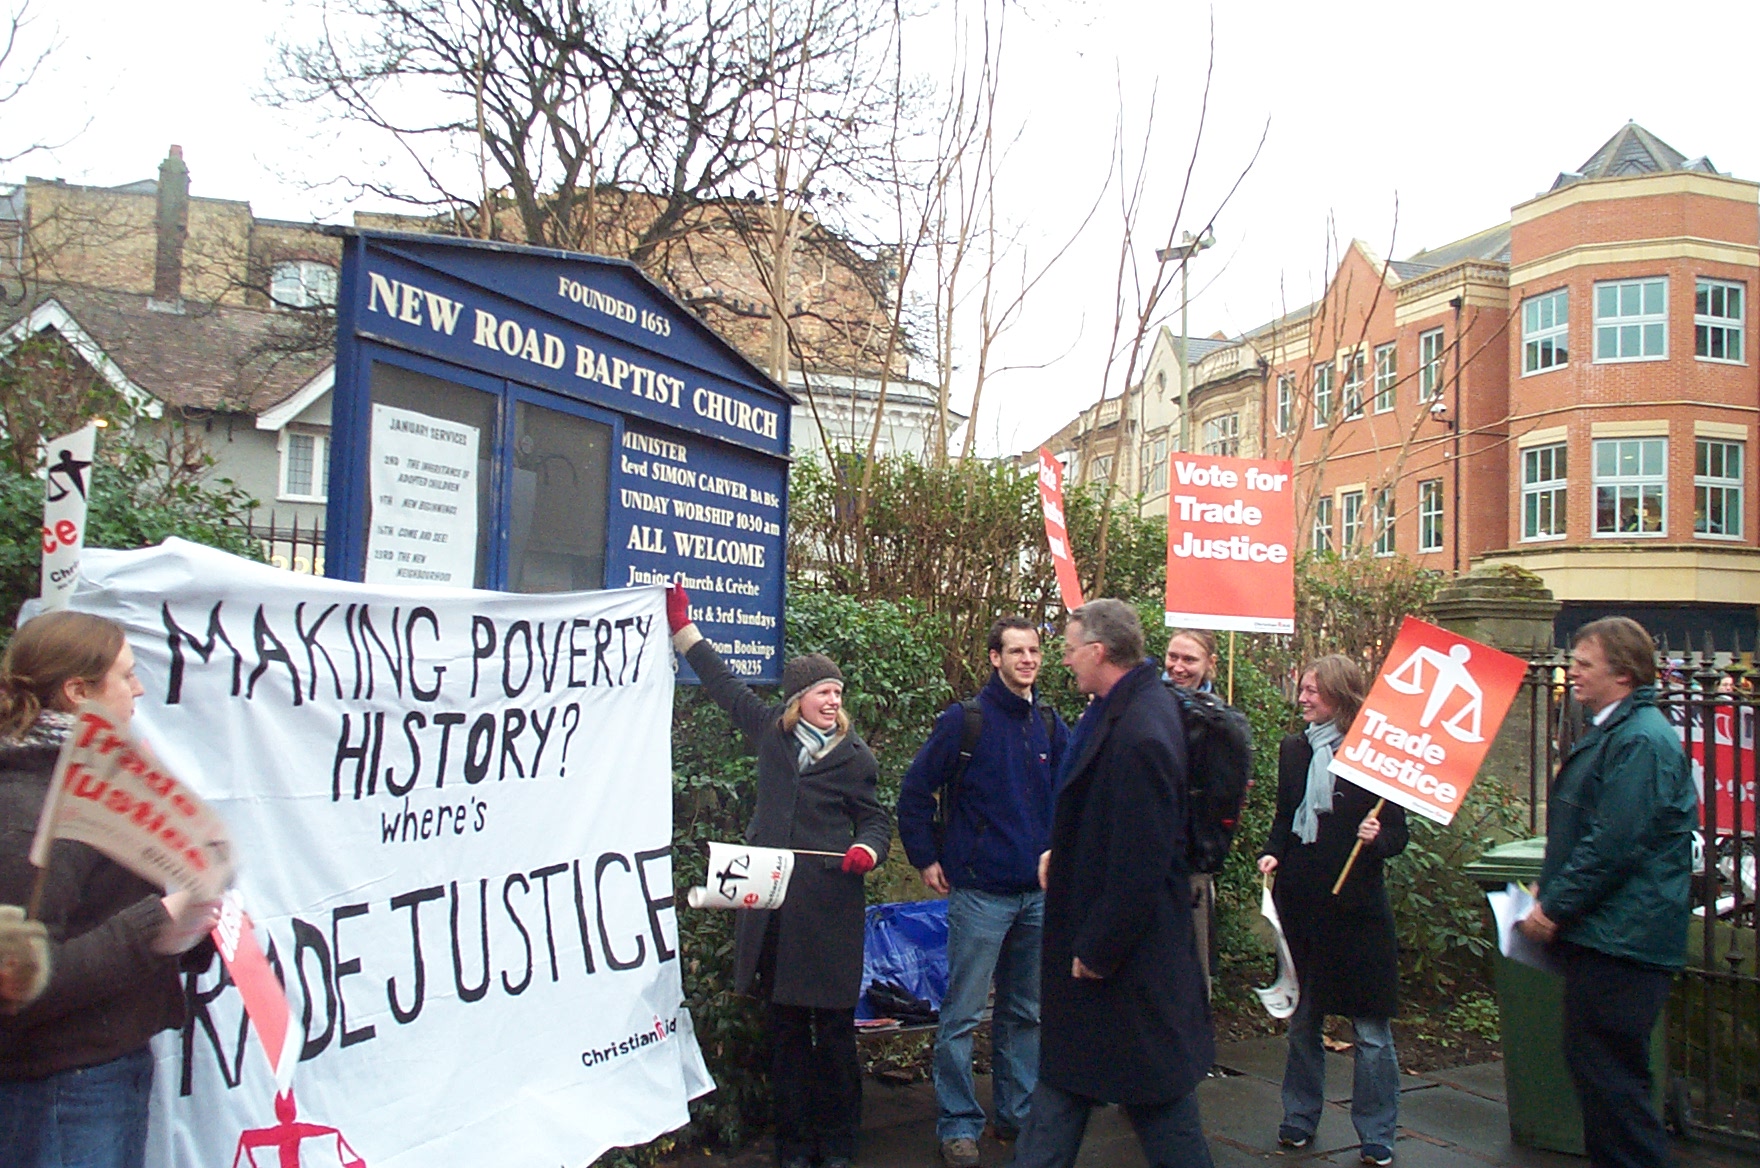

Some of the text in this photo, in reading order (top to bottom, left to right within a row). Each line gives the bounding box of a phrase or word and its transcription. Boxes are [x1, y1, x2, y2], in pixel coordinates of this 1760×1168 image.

[558, 276, 671, 337] FOUNDED 1653
[367, 271, 778, 440] NEW ROAD BAPTIST CHURCH
[389, 418, 467, 446] JANUARY SERVICES
[651, 462, 697, 489] SIMON
[699, 474, 748, 501] CARVER
[750, 488, 763, 505] BA
[1174, 460, 1288, 492] Vote for
[620, 488, 671, 516] UNDAY
[672, 499, 735, 528] WORSHIP
[1174, 495, 1263, 526] Trade
[626, 524, 765, 569] ALL WELCOME
[1173, 532, 1288, 564] Justice
[626, 565, 671, 588] Junior
[673, 571, 713, 594] Church
[715, 576, 724, 593] &
[687, 604, 776, 630] 1st & 3rd Sundays
[162, 600, 653, 706] MAKING POVERTY
[706, 638, 775, 660] oom Bookings
[331, 702, 581, 802] HISTORY?
[1362, 708, 1446, 766] Trade
[1344, 738, 1458, 804] Justice
[381, 796, 487, 844] where's
[387, 846, 677, 1025] JUSTICE
